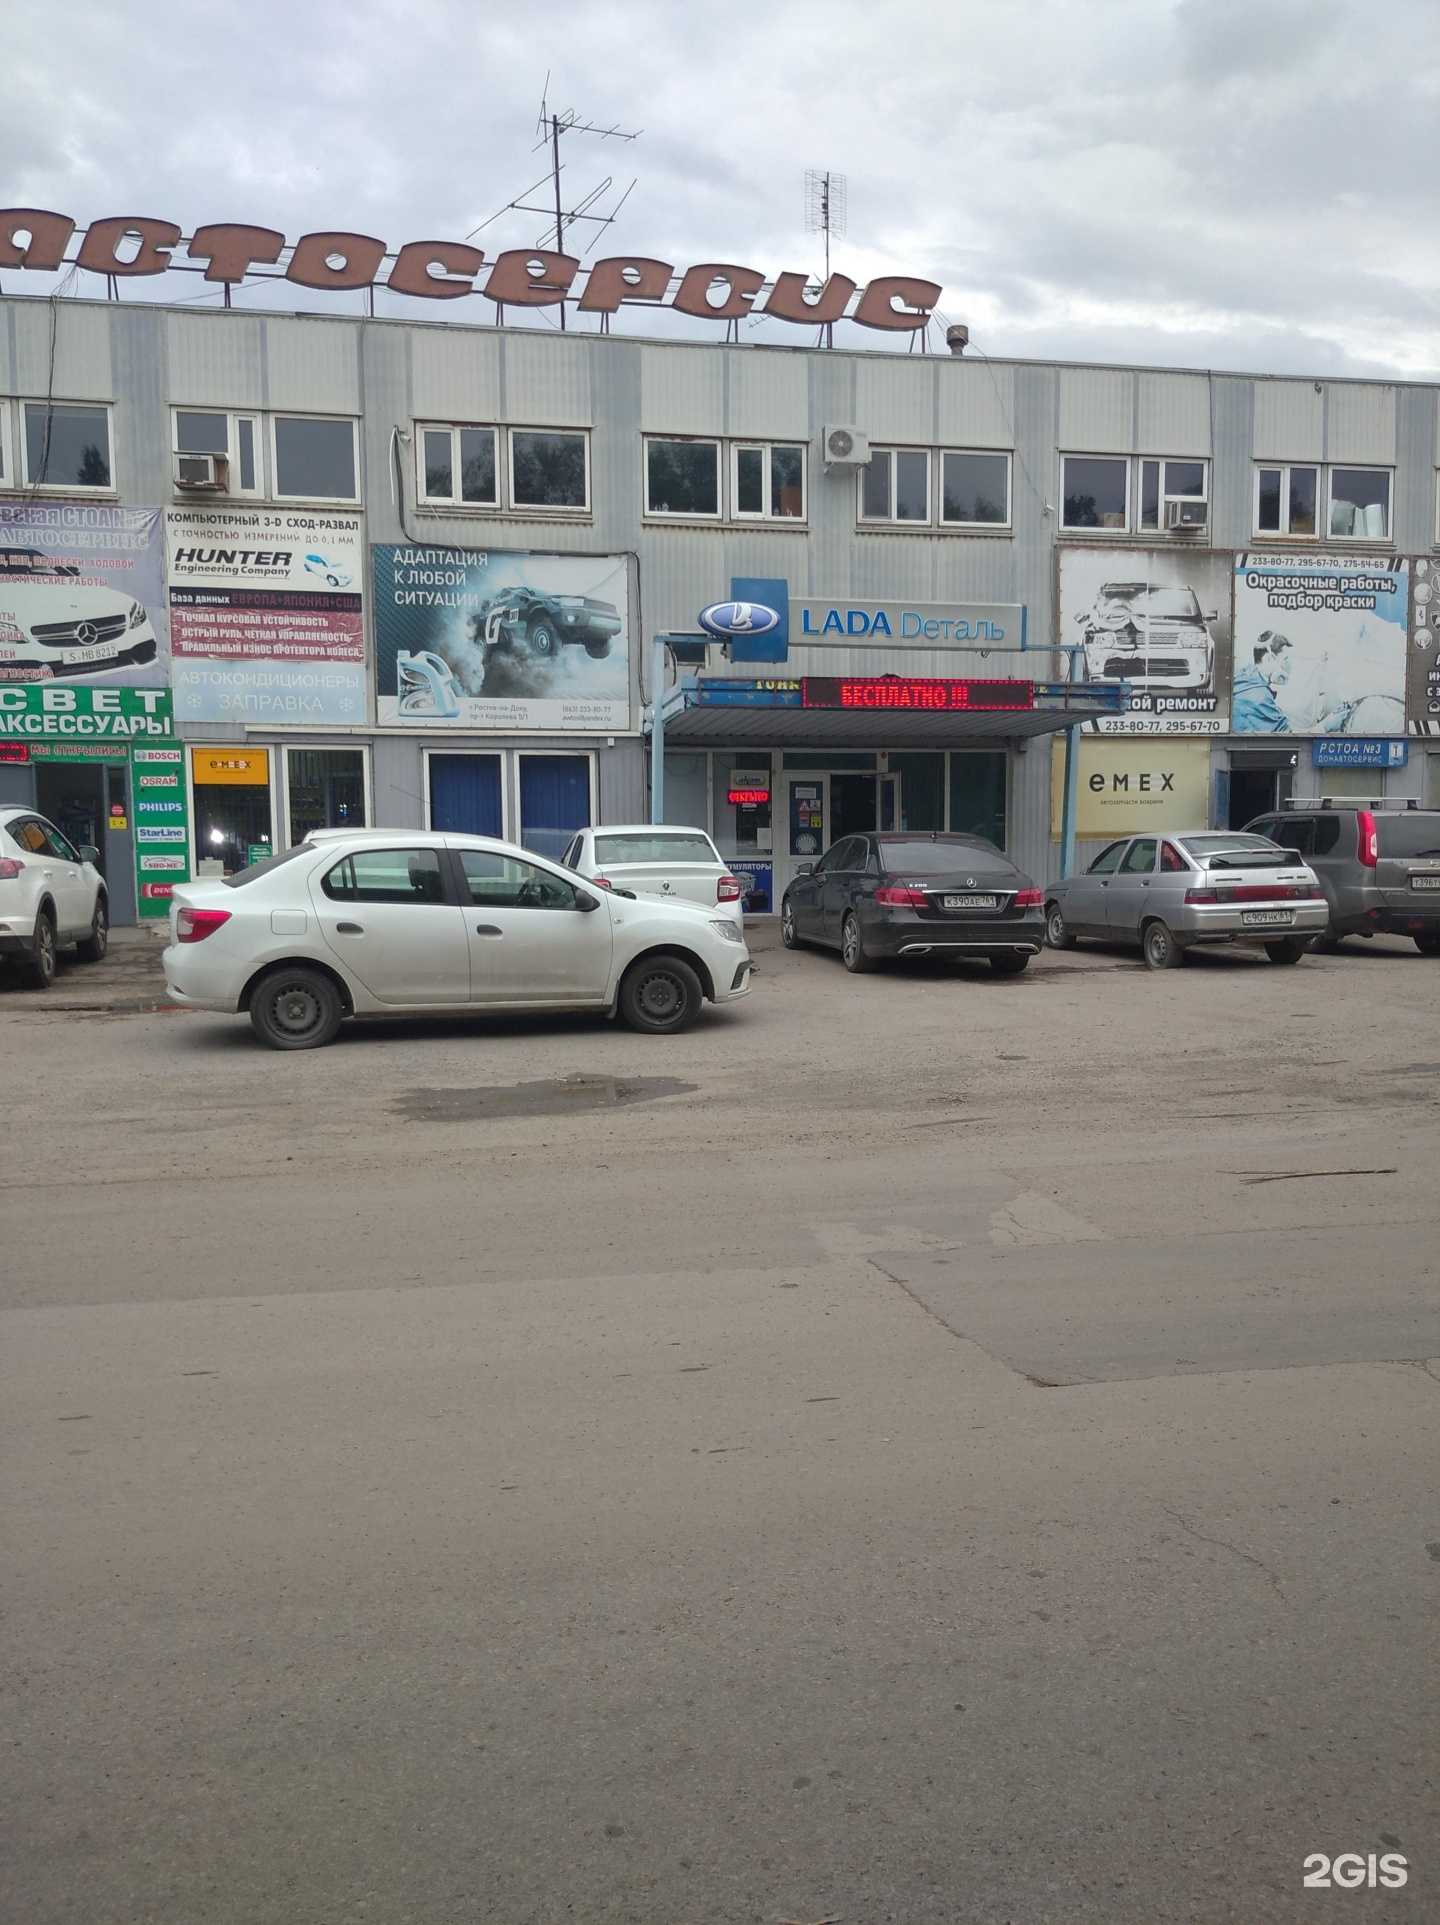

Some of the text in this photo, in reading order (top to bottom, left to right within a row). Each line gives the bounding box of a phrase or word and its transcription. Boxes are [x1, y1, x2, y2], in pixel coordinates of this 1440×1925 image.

[167, 513, 359, 531] КОМПЬЮТЕРНЫЙ 3-D СХОД-РАЗВАЛ
[182, 530, 240, 540] ТОЧНОСТЬЮ
[174, 548, 293, 567] HUNTER
[393, 550, 488, 567] АДАПТАЦИЯ
[174, 563, 292, 578] Engineering Company
[394, 569, 466, 586] К ЛЮБОЙ
[1248, 574, 1396, 592] Окрасочные работы,
[171, 593, 193, 603] База
[195, 595, 231, 605] данных
[394, 591, 479, 609] СИТУАЦИИ
[1268, 593, 1376, 611] подбор краски
[802, 608, 892, 636] LADA
[180, 671, 359, 689] АВТОКОНДИЦИОНЕРЫ
[0, 688, 165, 713] СВЕТ
[219, 694, 324, 713] ЗАПРАВКА
[841, 684, 947, 707] БЕСПЛАТНО
[1156, 697, 1217, 714] ремонт
[1105, 721, 1220, 732] 233-80-77, 295-67-70
[147, 752, 180, 760] BOSCH
[141, 777, 178, 786] OSRAM
[138, 802, 183, 812] PHILIPS
[139, 829, 183, 837] StarLine
